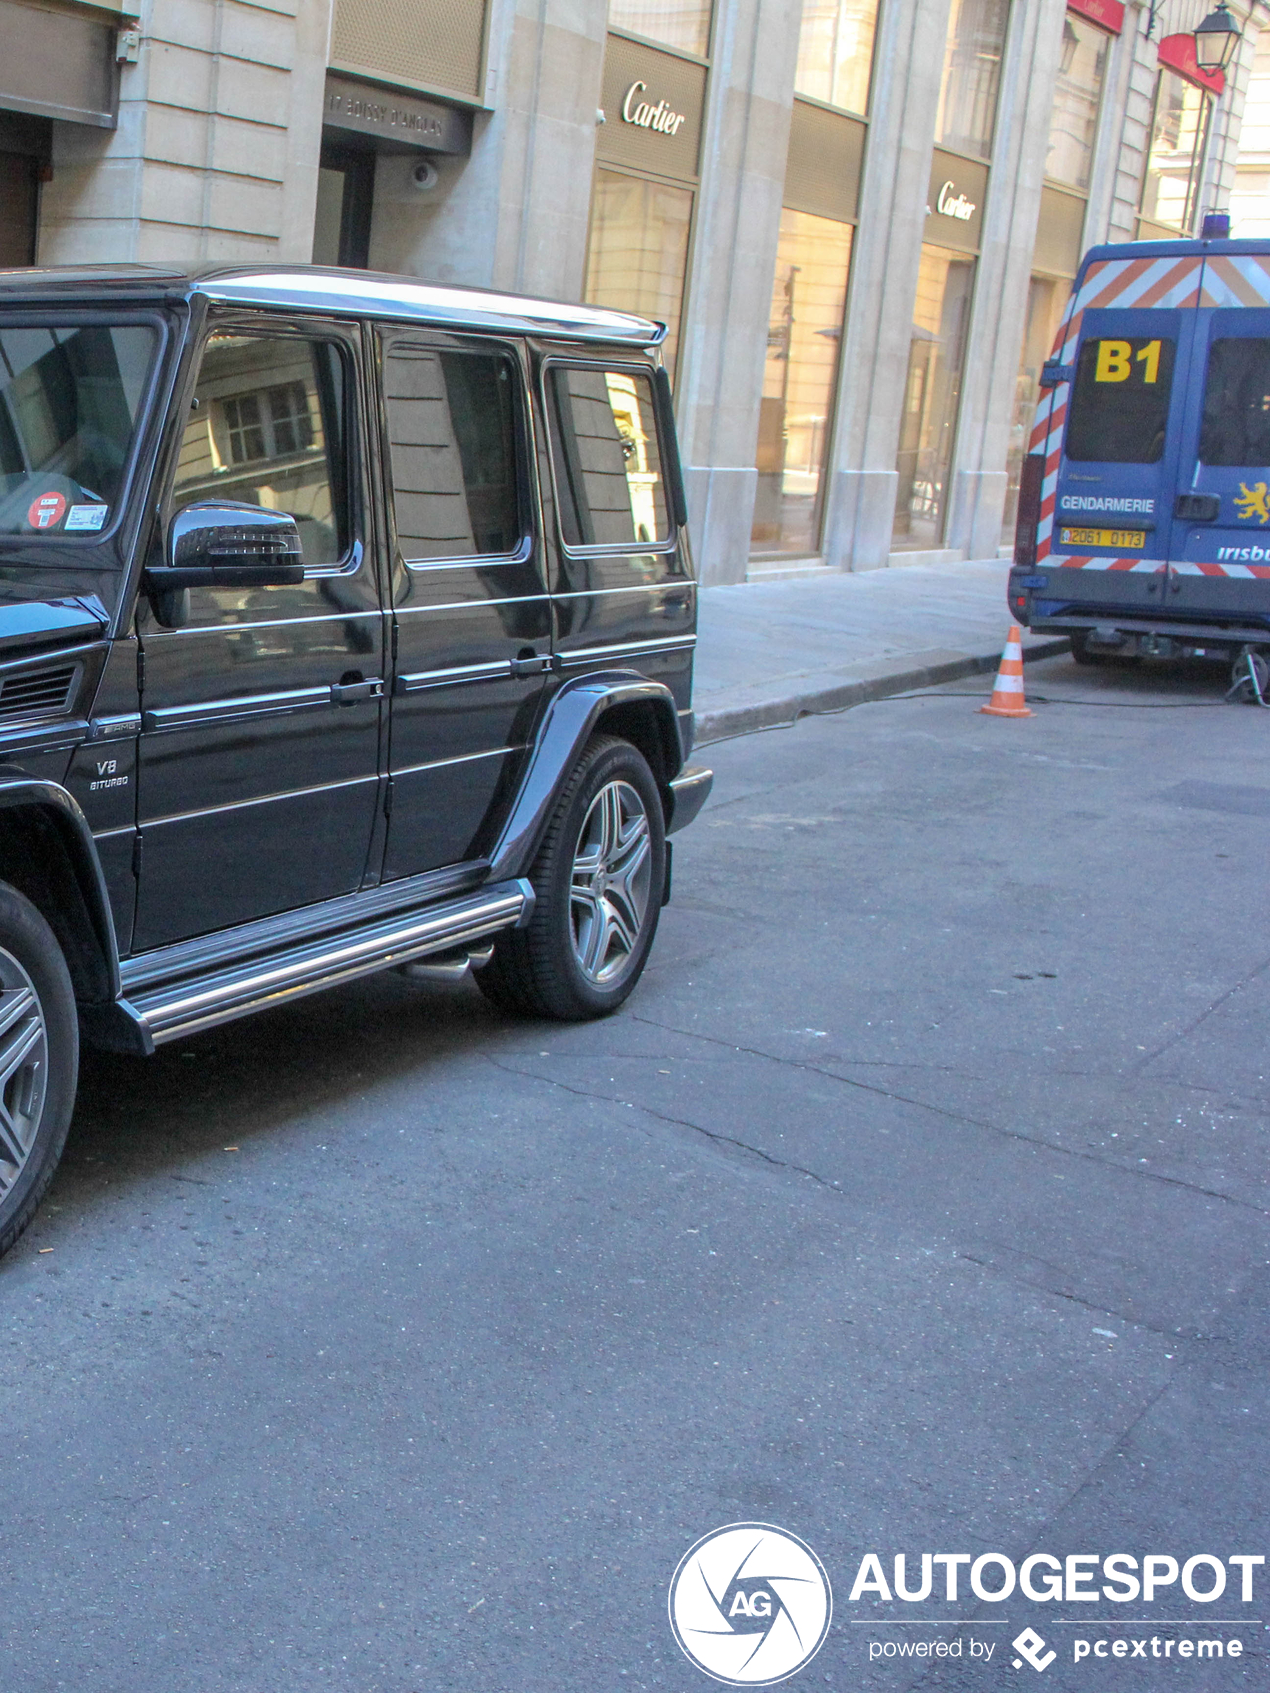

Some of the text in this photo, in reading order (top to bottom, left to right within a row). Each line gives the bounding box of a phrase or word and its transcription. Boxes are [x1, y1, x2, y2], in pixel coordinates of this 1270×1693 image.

[330, 95, 342, 111] 17
[347, 99, 388, 122] BOISSY
[623, 80, 685, 136] Cartier
[937, 180, 977, 221] Cartier
[1095, 340, 1162, 384] B1
[1061, 495, 1155, 514] GENDARMERIE
[1110, 531, 1142, 547] 0173
[96, 759, 117, 776] V8
[89, 775, 129, 791] BITURBO
